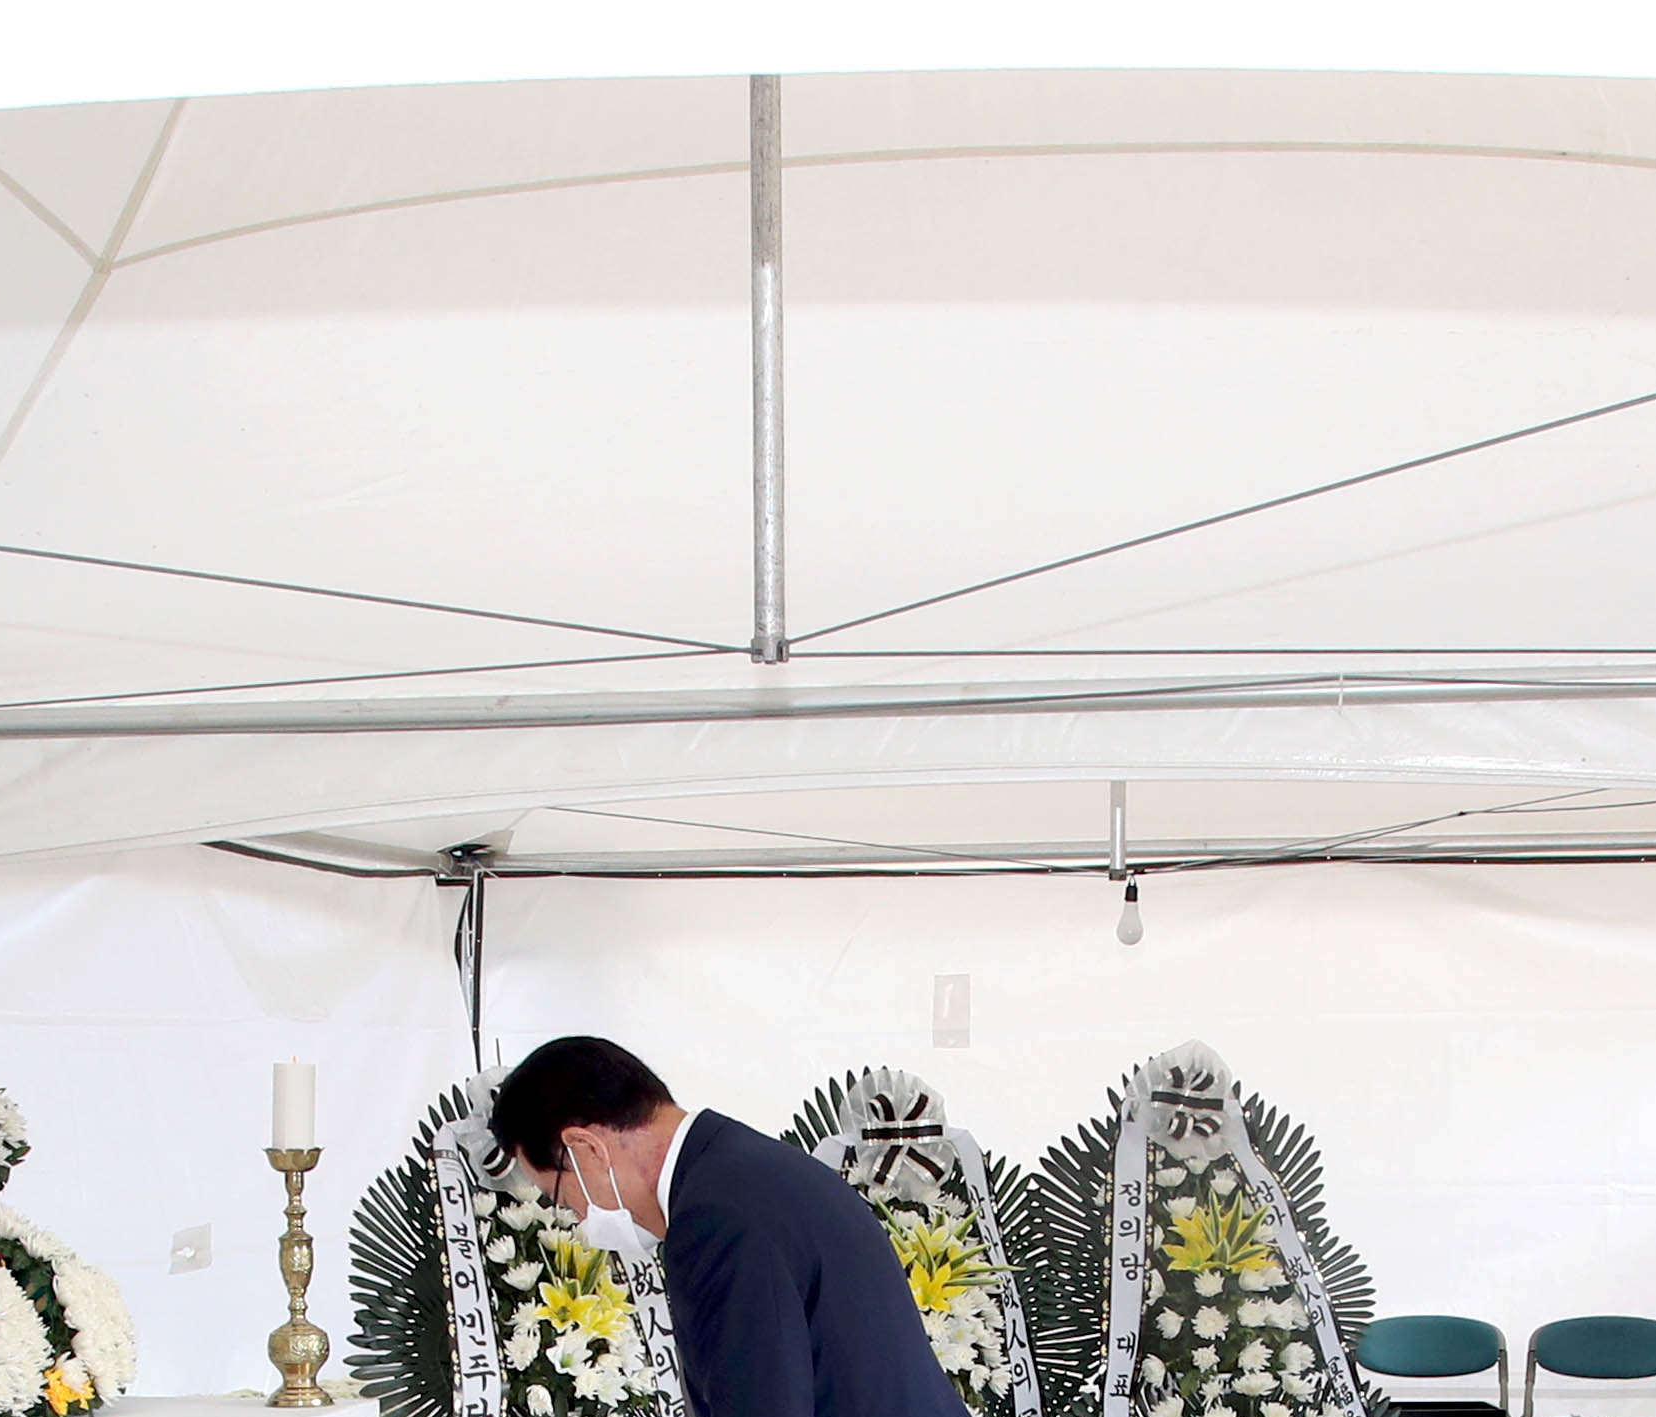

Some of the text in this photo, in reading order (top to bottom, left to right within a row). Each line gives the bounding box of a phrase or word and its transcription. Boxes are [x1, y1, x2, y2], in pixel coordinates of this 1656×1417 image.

[1117, 1180, 1146, 1282] 정의당
[630, 1259, 680, 1383] 故人의
[1109, 1331, 1137, 1398] 대표
